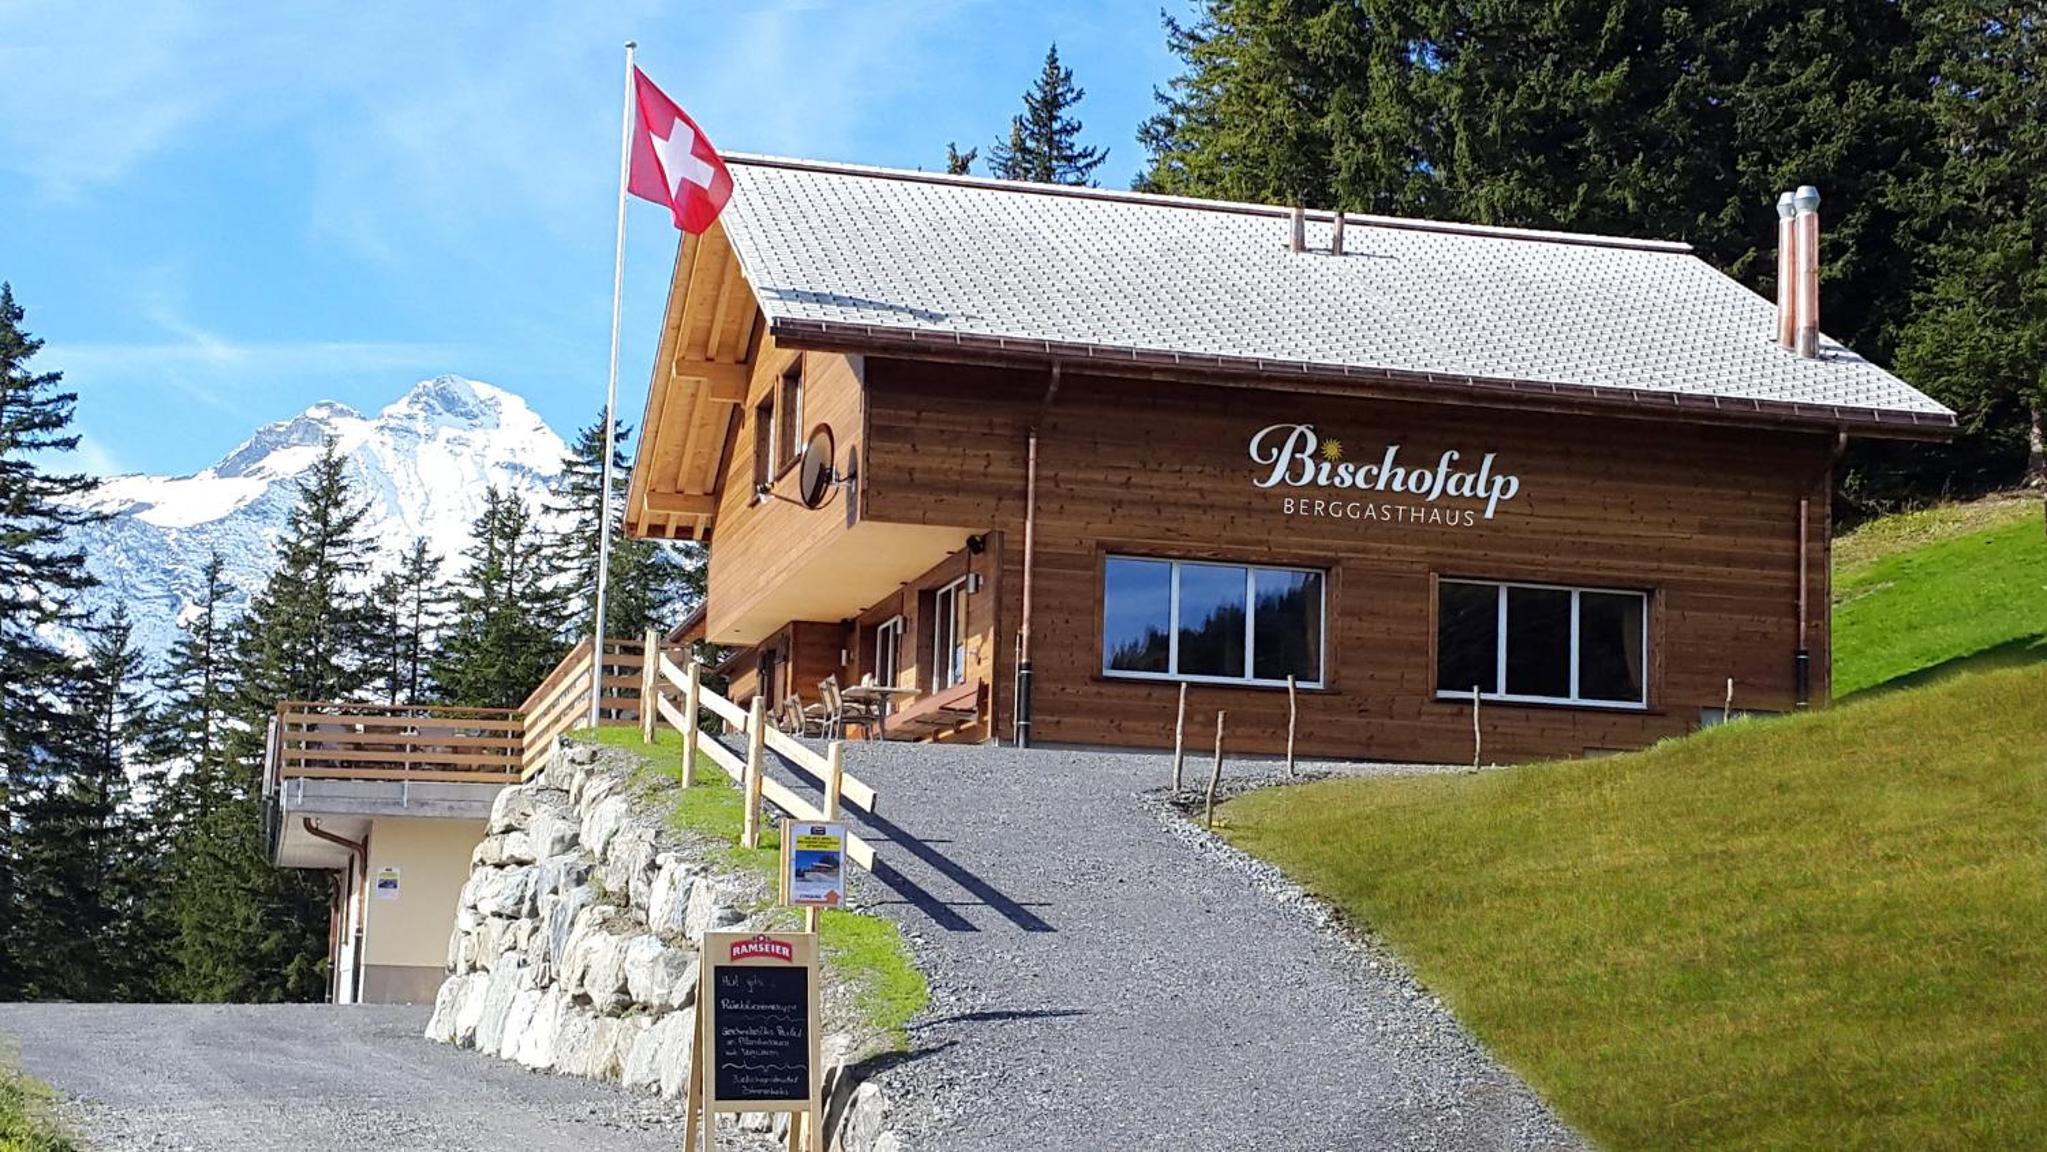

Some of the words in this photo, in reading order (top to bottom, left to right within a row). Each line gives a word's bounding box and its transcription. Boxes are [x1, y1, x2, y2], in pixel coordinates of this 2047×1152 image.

[1249, 423, 1520, 519] Bischofalp
[1283, 497, 1475, 527] BERGGASTHAUS
[732, 943, 791, 957] RAMSEIER
